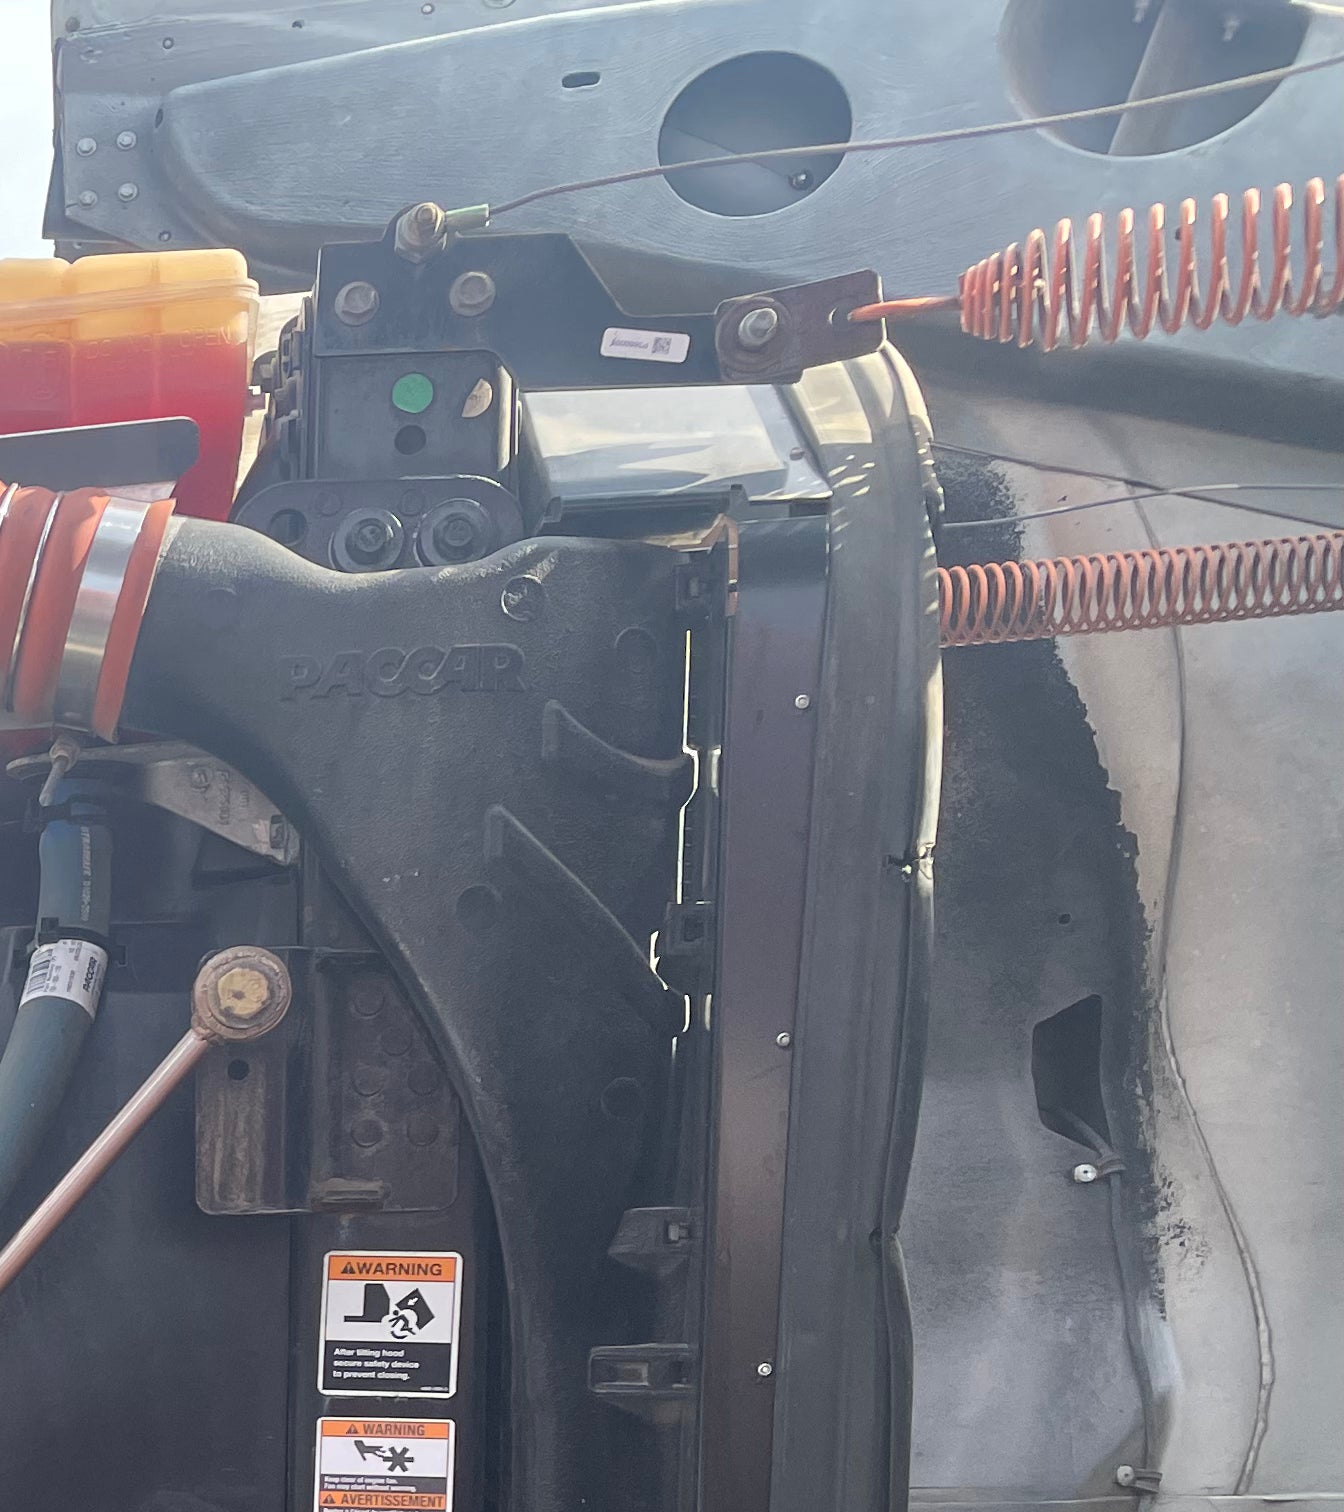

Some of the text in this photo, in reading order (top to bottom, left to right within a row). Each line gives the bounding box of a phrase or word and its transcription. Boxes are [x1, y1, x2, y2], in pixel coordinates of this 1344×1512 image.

[280, 643, 526, 700] PACCAR
[357, 1262, 442, 1276] WARNING
[334, 1348, 355, 1356] After
[382, 1349, 405, 1357] hood
[364, 1360, 390, 1369] safety
[391, 1361, 420, 1369] device
[333, 1370, 410, 1380] to prevent closing.
[363, 1423, 425, 1436] WARNING
[341, 1494, 444, 1508] AVERTISSEMENT
